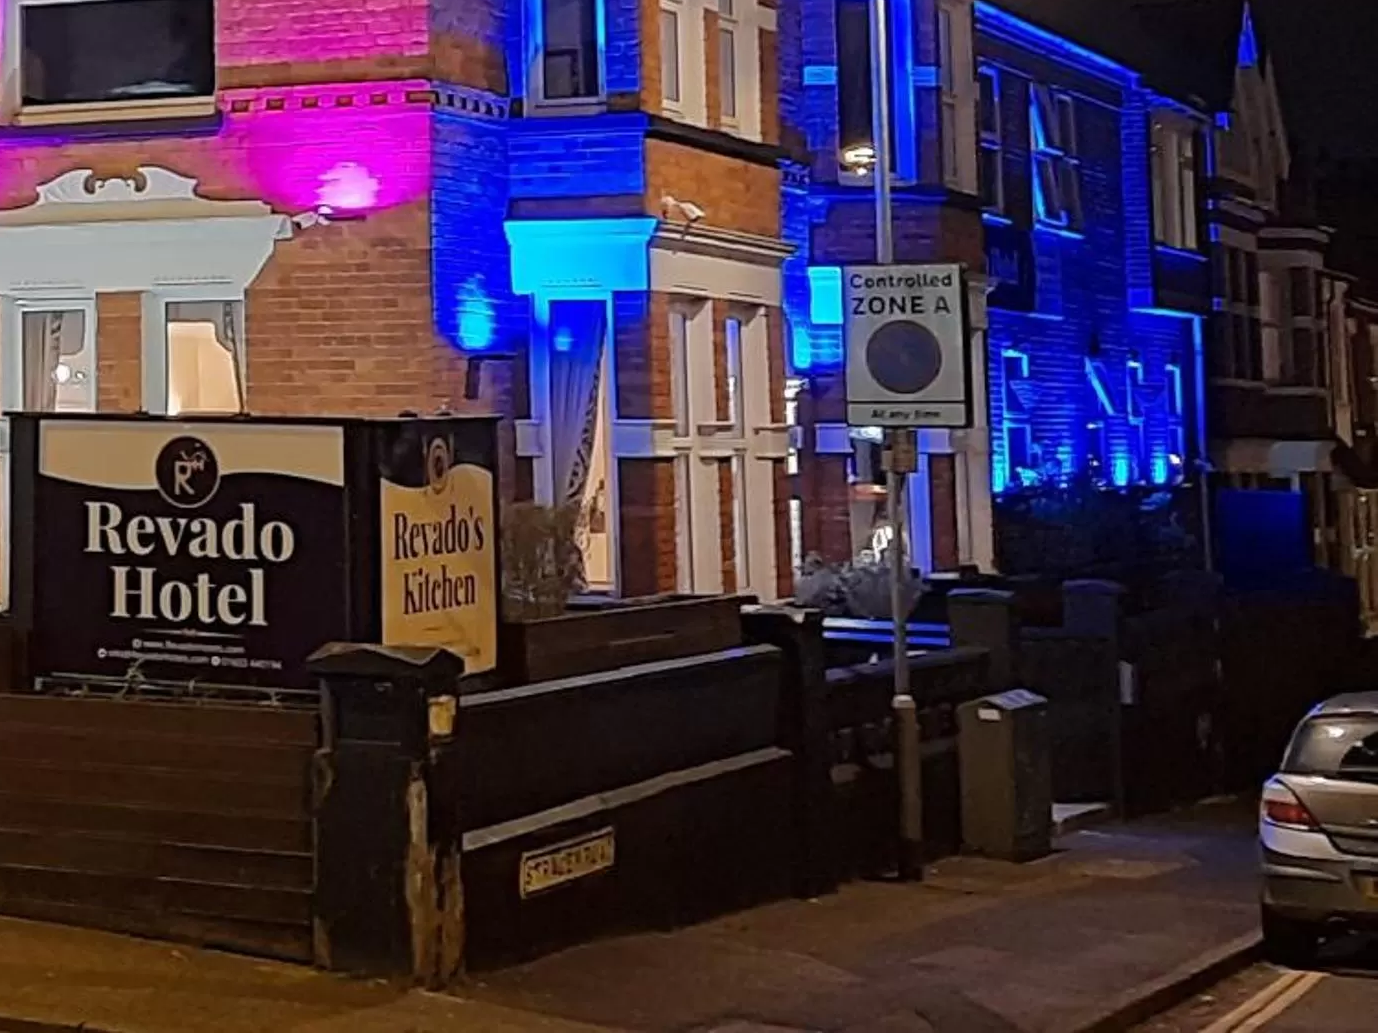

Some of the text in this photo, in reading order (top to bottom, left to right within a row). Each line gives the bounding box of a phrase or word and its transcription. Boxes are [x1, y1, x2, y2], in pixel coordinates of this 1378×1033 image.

[850, 273, 953, 289] Controlled
[851, 295, 952, 316] ZONE A
[83, 500, 295, 563] Revado
[393, 503, 485, 561] Revado's
[109, 565, 269, 627] Hotel
[402, 564, 476, 615] Kitchen
